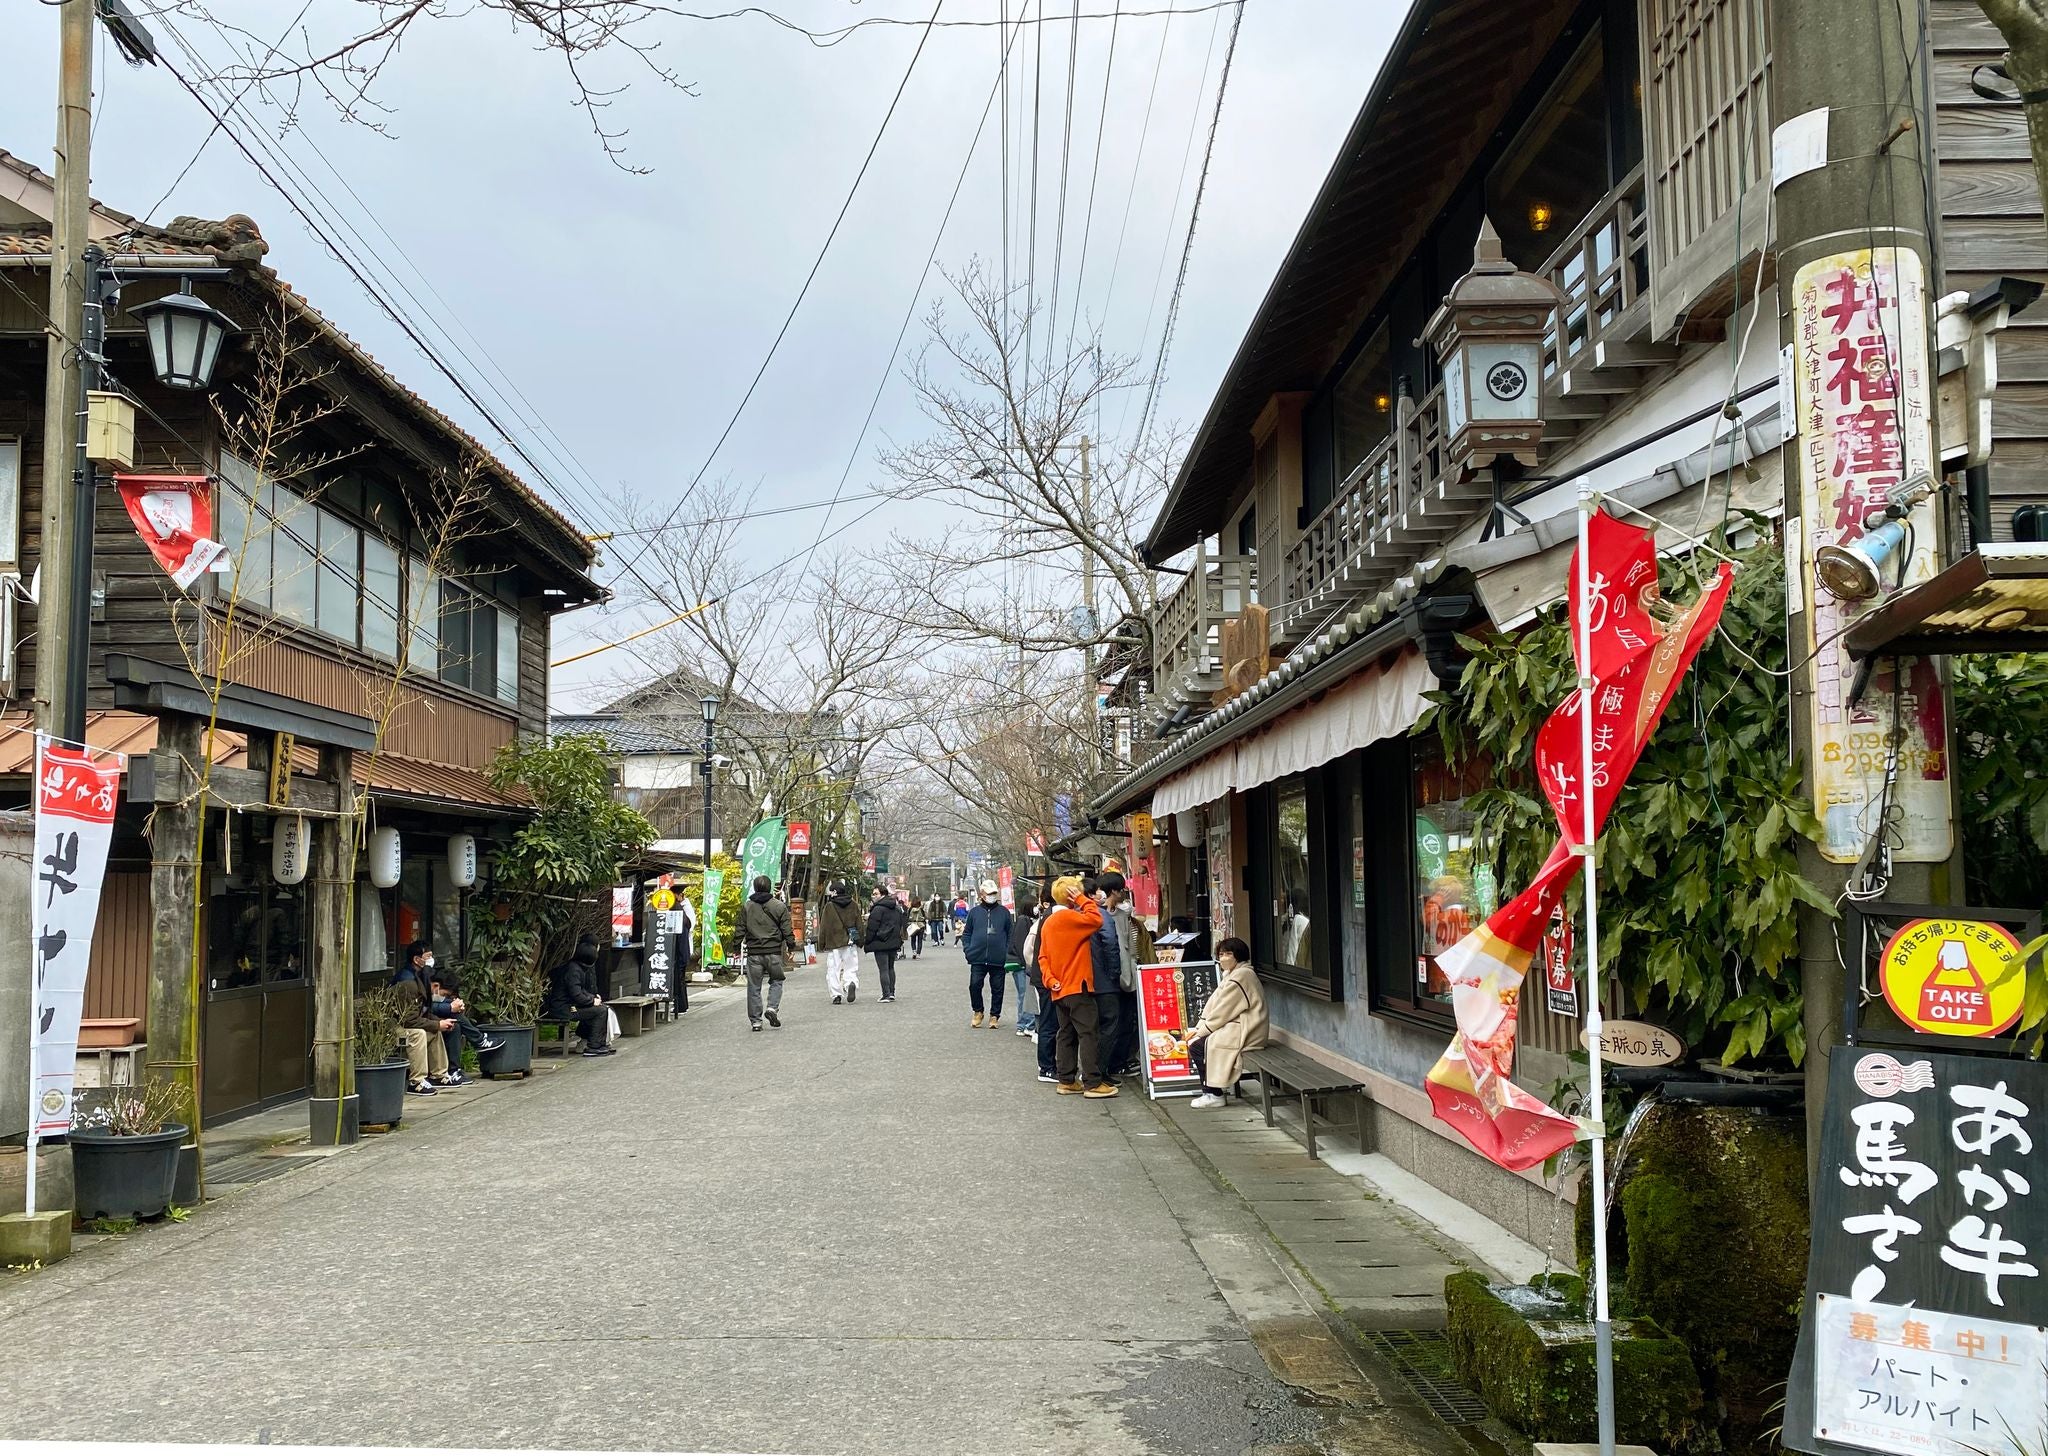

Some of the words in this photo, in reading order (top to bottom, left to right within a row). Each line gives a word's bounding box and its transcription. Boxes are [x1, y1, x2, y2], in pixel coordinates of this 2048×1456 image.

[1591, 558, 1651, 788] 肉の旨極まる
[1155, 974, 1169, 1024] あか牛丼
[1924, 988, 1985, 1006] TAKE
[1930, 1006, 1977, 1021] OUT
[1940, 1080, 2040, 1308] あか牛
[1858, 1388, 1991, 1431] アルバイト
